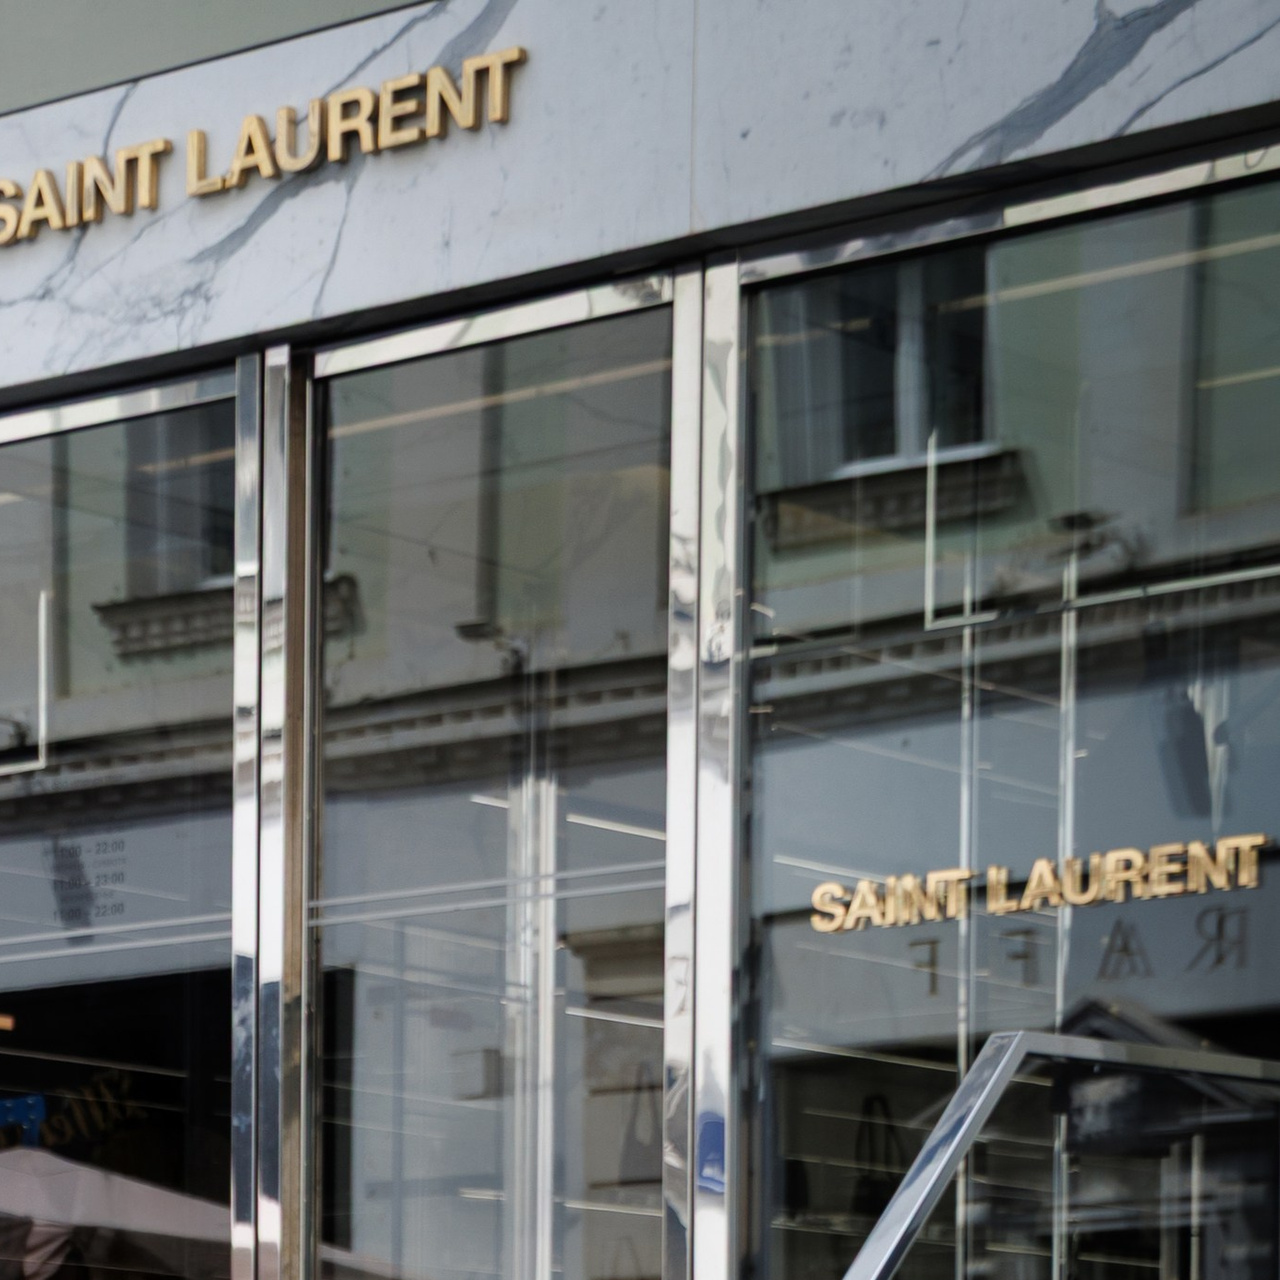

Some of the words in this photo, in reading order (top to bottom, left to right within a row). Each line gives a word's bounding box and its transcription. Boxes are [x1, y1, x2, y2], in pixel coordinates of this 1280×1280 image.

[186, 46, 528, 197] LAURENT
[53, 847, 81, 859] 1:00
[95, 839, 125, 856] 22:00
[95, 871, 125, 888] 23:00
[810, 867, 974, 933] SAINT
[986, 833, 1268, 915] LAURENT
[95, 902, 125, 919] 22:00
